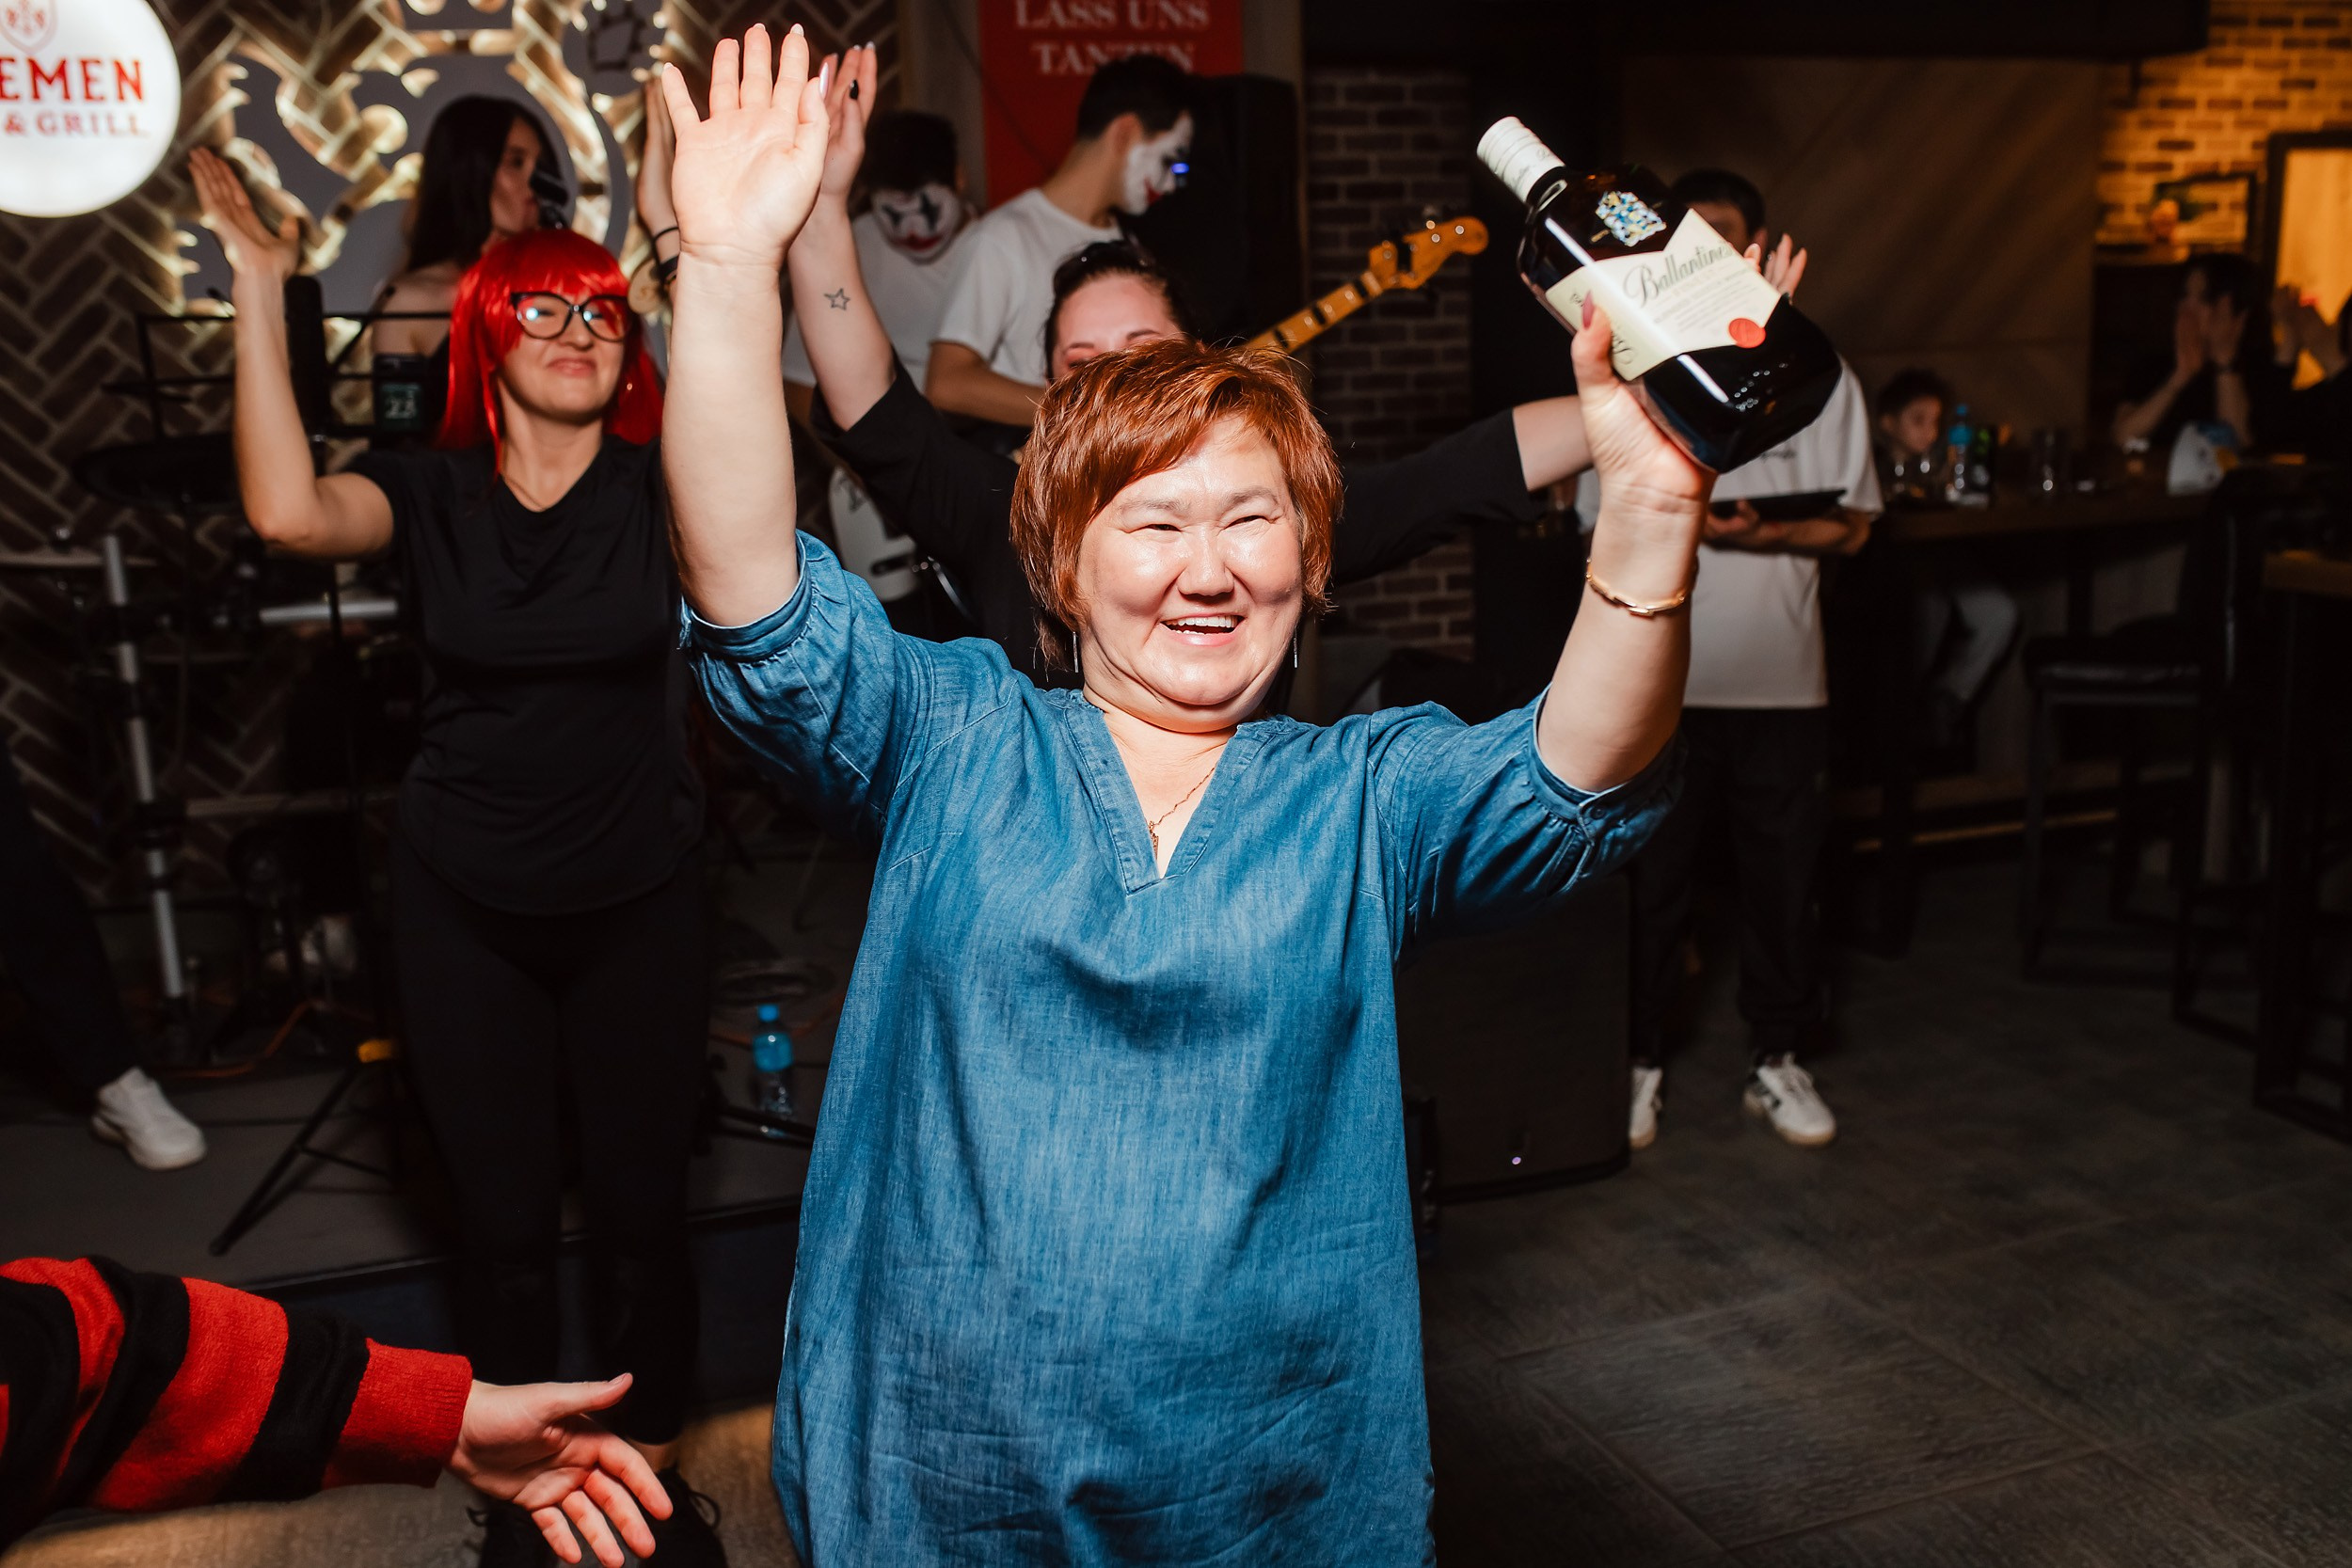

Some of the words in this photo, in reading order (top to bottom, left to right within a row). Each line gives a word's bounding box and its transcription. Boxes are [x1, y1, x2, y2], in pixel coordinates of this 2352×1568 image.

[1015, 0, 1117, 29] LASS
[1128, 0, 1210, 29] UNS
[1032, 42, 1195, 75] TANN
[0, 55, 144, 102] EMEN
[5, 111, 25, 135] &
[35, 111, 150, 136] GRILL
